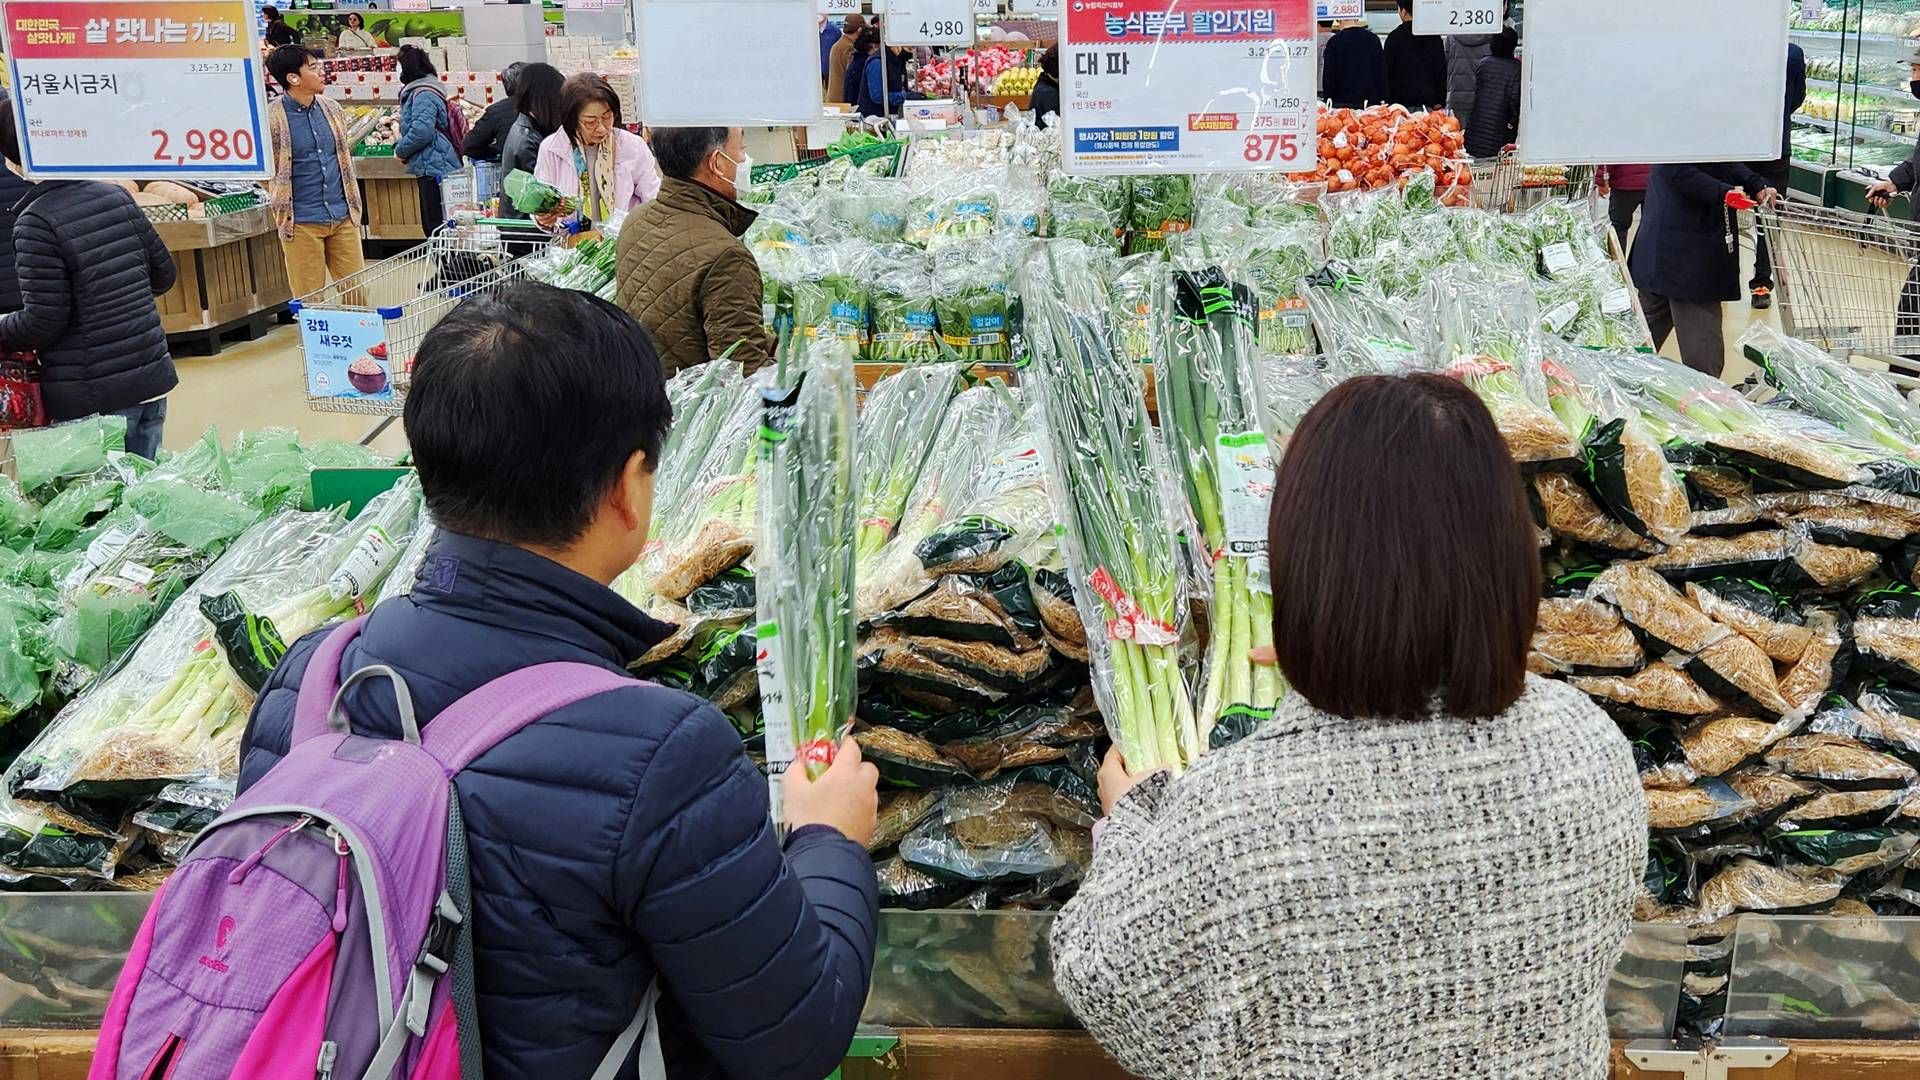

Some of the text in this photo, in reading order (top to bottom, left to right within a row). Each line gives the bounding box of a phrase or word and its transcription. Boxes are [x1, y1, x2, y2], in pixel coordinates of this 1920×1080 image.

[1333, 5, 1359, 14] 2,880
[16, 18, 60, 31] 대한민국
[1105, 9, 1274, 36] 농식품부 할인지원
[1450, 10, 1494, 27] 2,380
[84, 17, 237, 43] 살 맛나는 가격!
[919, 21, 963, 38] 4,980
[26, 32, 76, 45] 살맛나게!
[1076, 52, 1130, 75] 대 파
[23, 74, 118, 95] 겨울시금치
[1076, 90, 1089, 98] 국산
[25, 98, 32, 106] 단
[1098, 100, 1112, 109] 한정
[1274, 98, 1300, 108] 1,250
[29, 119, 42, 127] 국산
[1079, 131, 1109, 141] 행사기간
[151, 129, 253, 165] 2,980
[1244, 134, 1297, 161] 875
[306, 319, 329, 333] 강화
[975, 317, 1000, 327] 얼갈이
[320, 335, 353, 349] 새우젓
